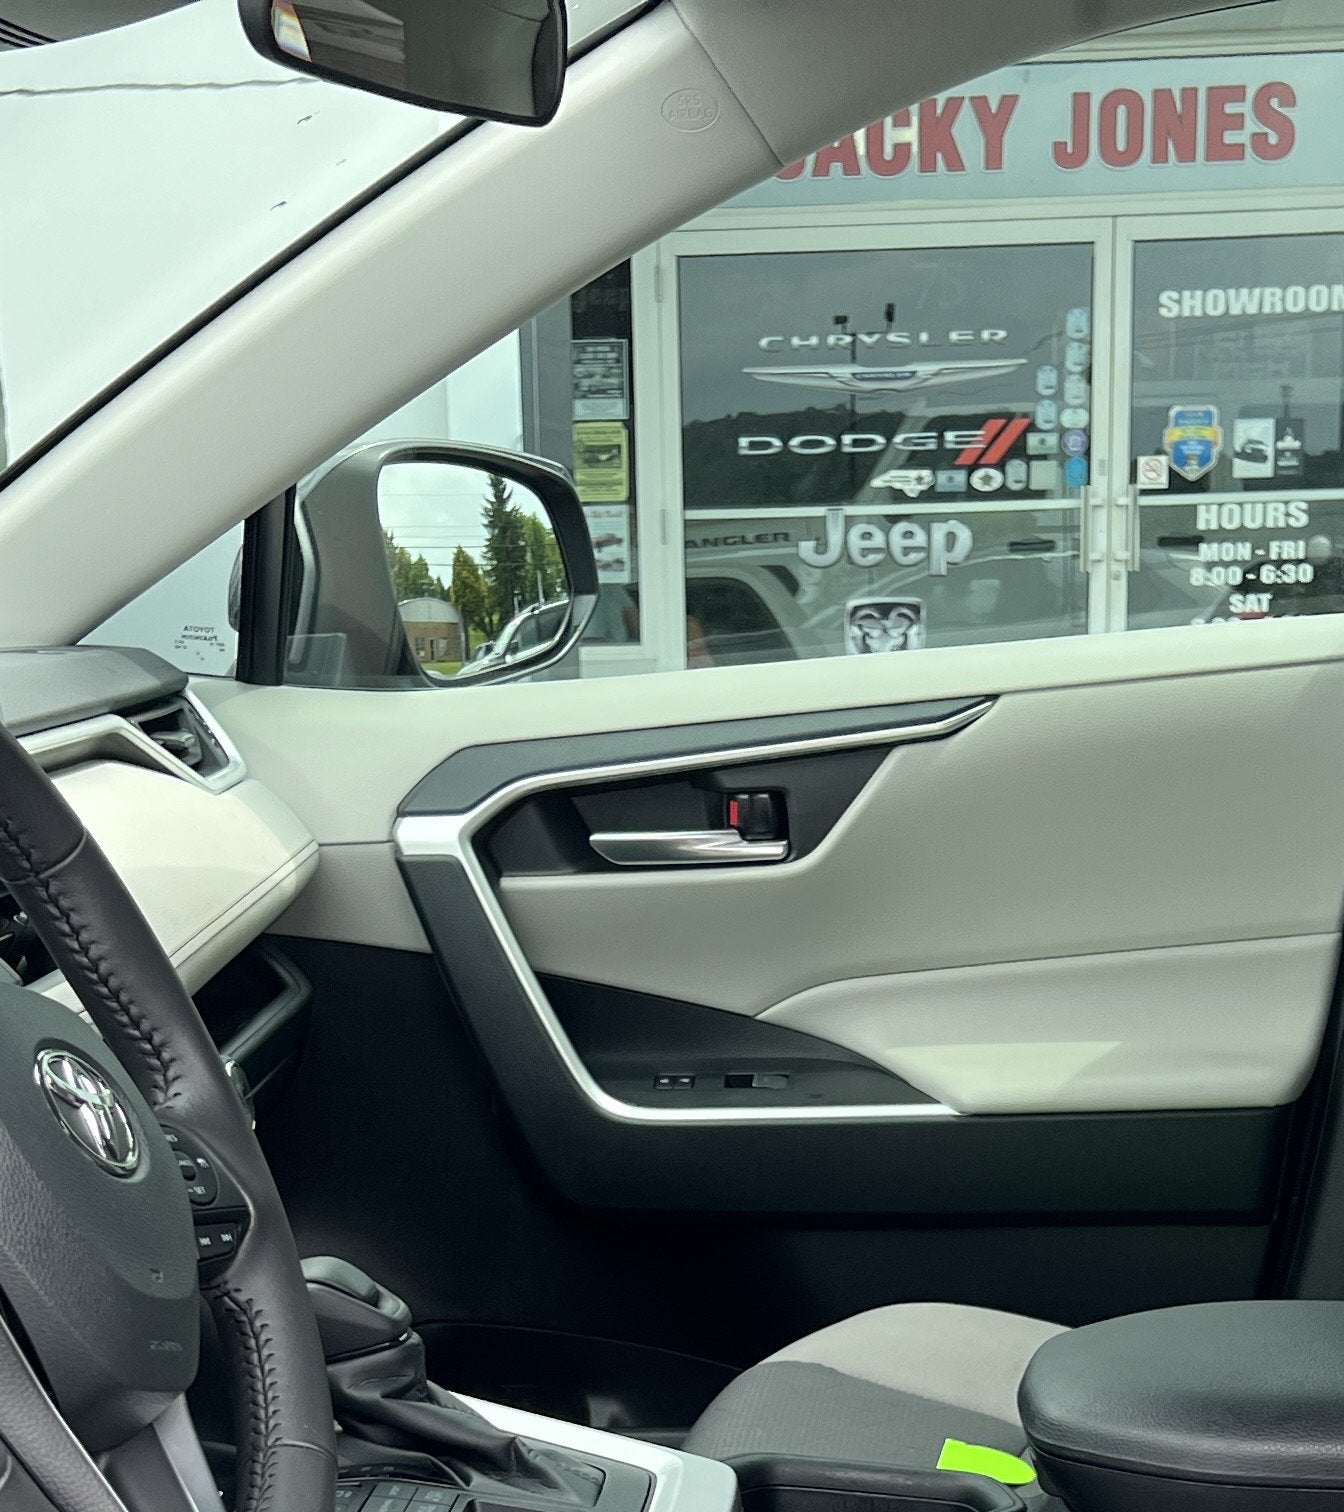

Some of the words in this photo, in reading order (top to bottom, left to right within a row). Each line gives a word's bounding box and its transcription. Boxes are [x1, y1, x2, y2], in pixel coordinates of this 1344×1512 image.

[773, 93, 1020, 181] ACKY
[1052, 80, 1297, 169] JONES
[758, 328, 1009, 351] CHRYSLER
[737, 429, 987, 455] DODGE
[1196, 500, 1310, 531] HOURS
[798, 507, 974, 577] Jeep
[1198, 541, 1253, 562] MON
[1269, 540, 1307, 561] FRI
[1259, 562, 1315, 585] 6:30
[1228, 593, 1273, 613] SAT
